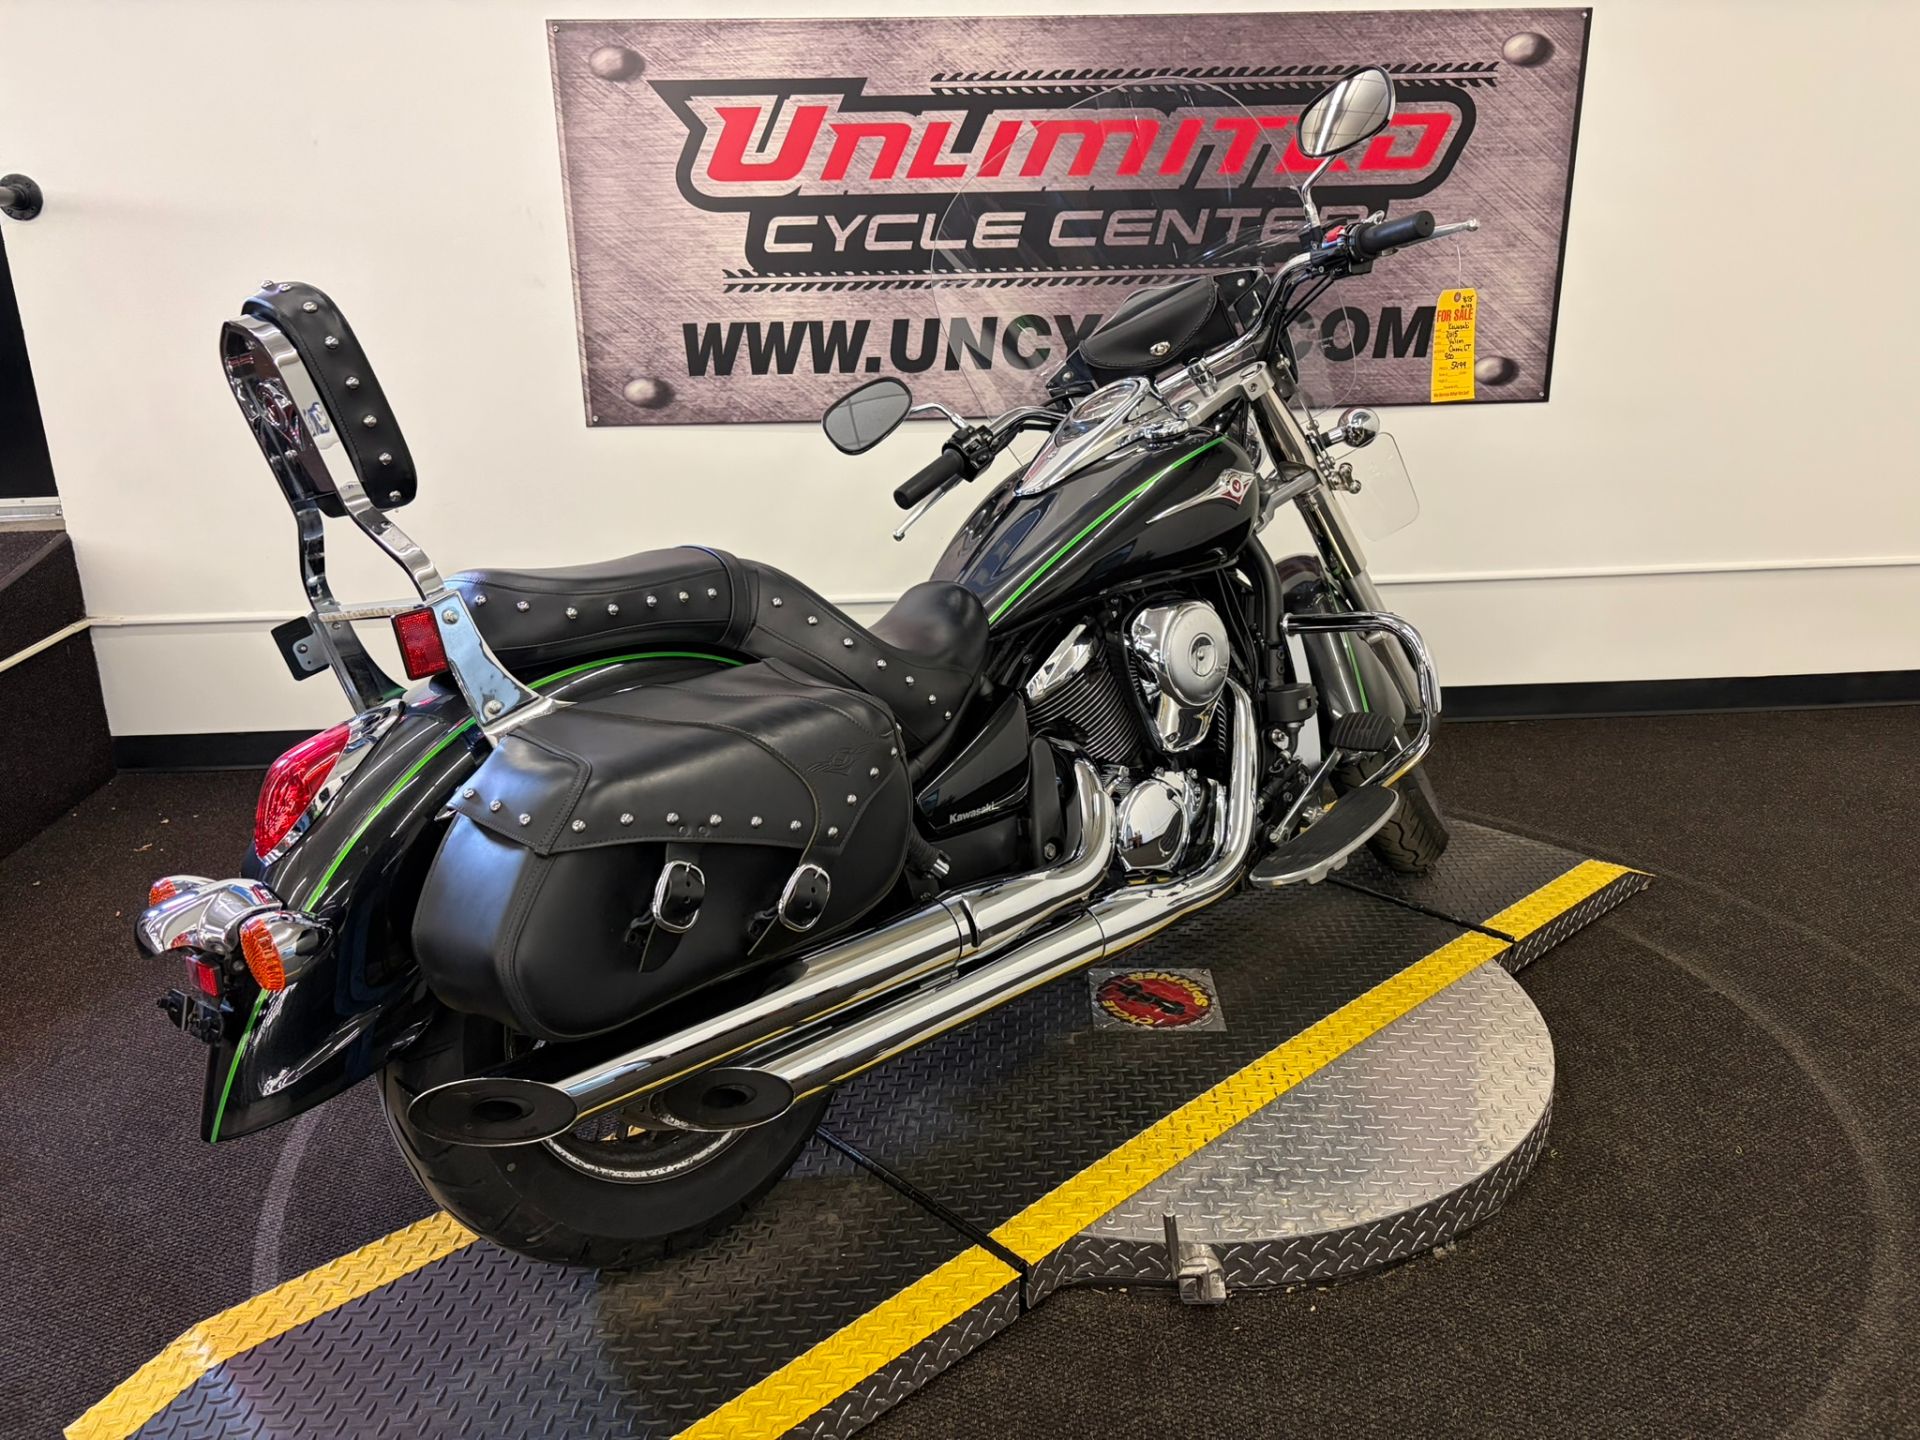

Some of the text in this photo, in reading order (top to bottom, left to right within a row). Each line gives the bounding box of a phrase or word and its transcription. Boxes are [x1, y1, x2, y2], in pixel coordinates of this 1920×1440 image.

[764, 212, 1027, 252] CYCLE
[1437, 308, 1473, 322] FOR SALE
[949, 801, 996, 825] Kawasaki
[1128, 972, 1209, 1007] SPINNER
[1102, 1000, 1154, 1025] CYCLE
